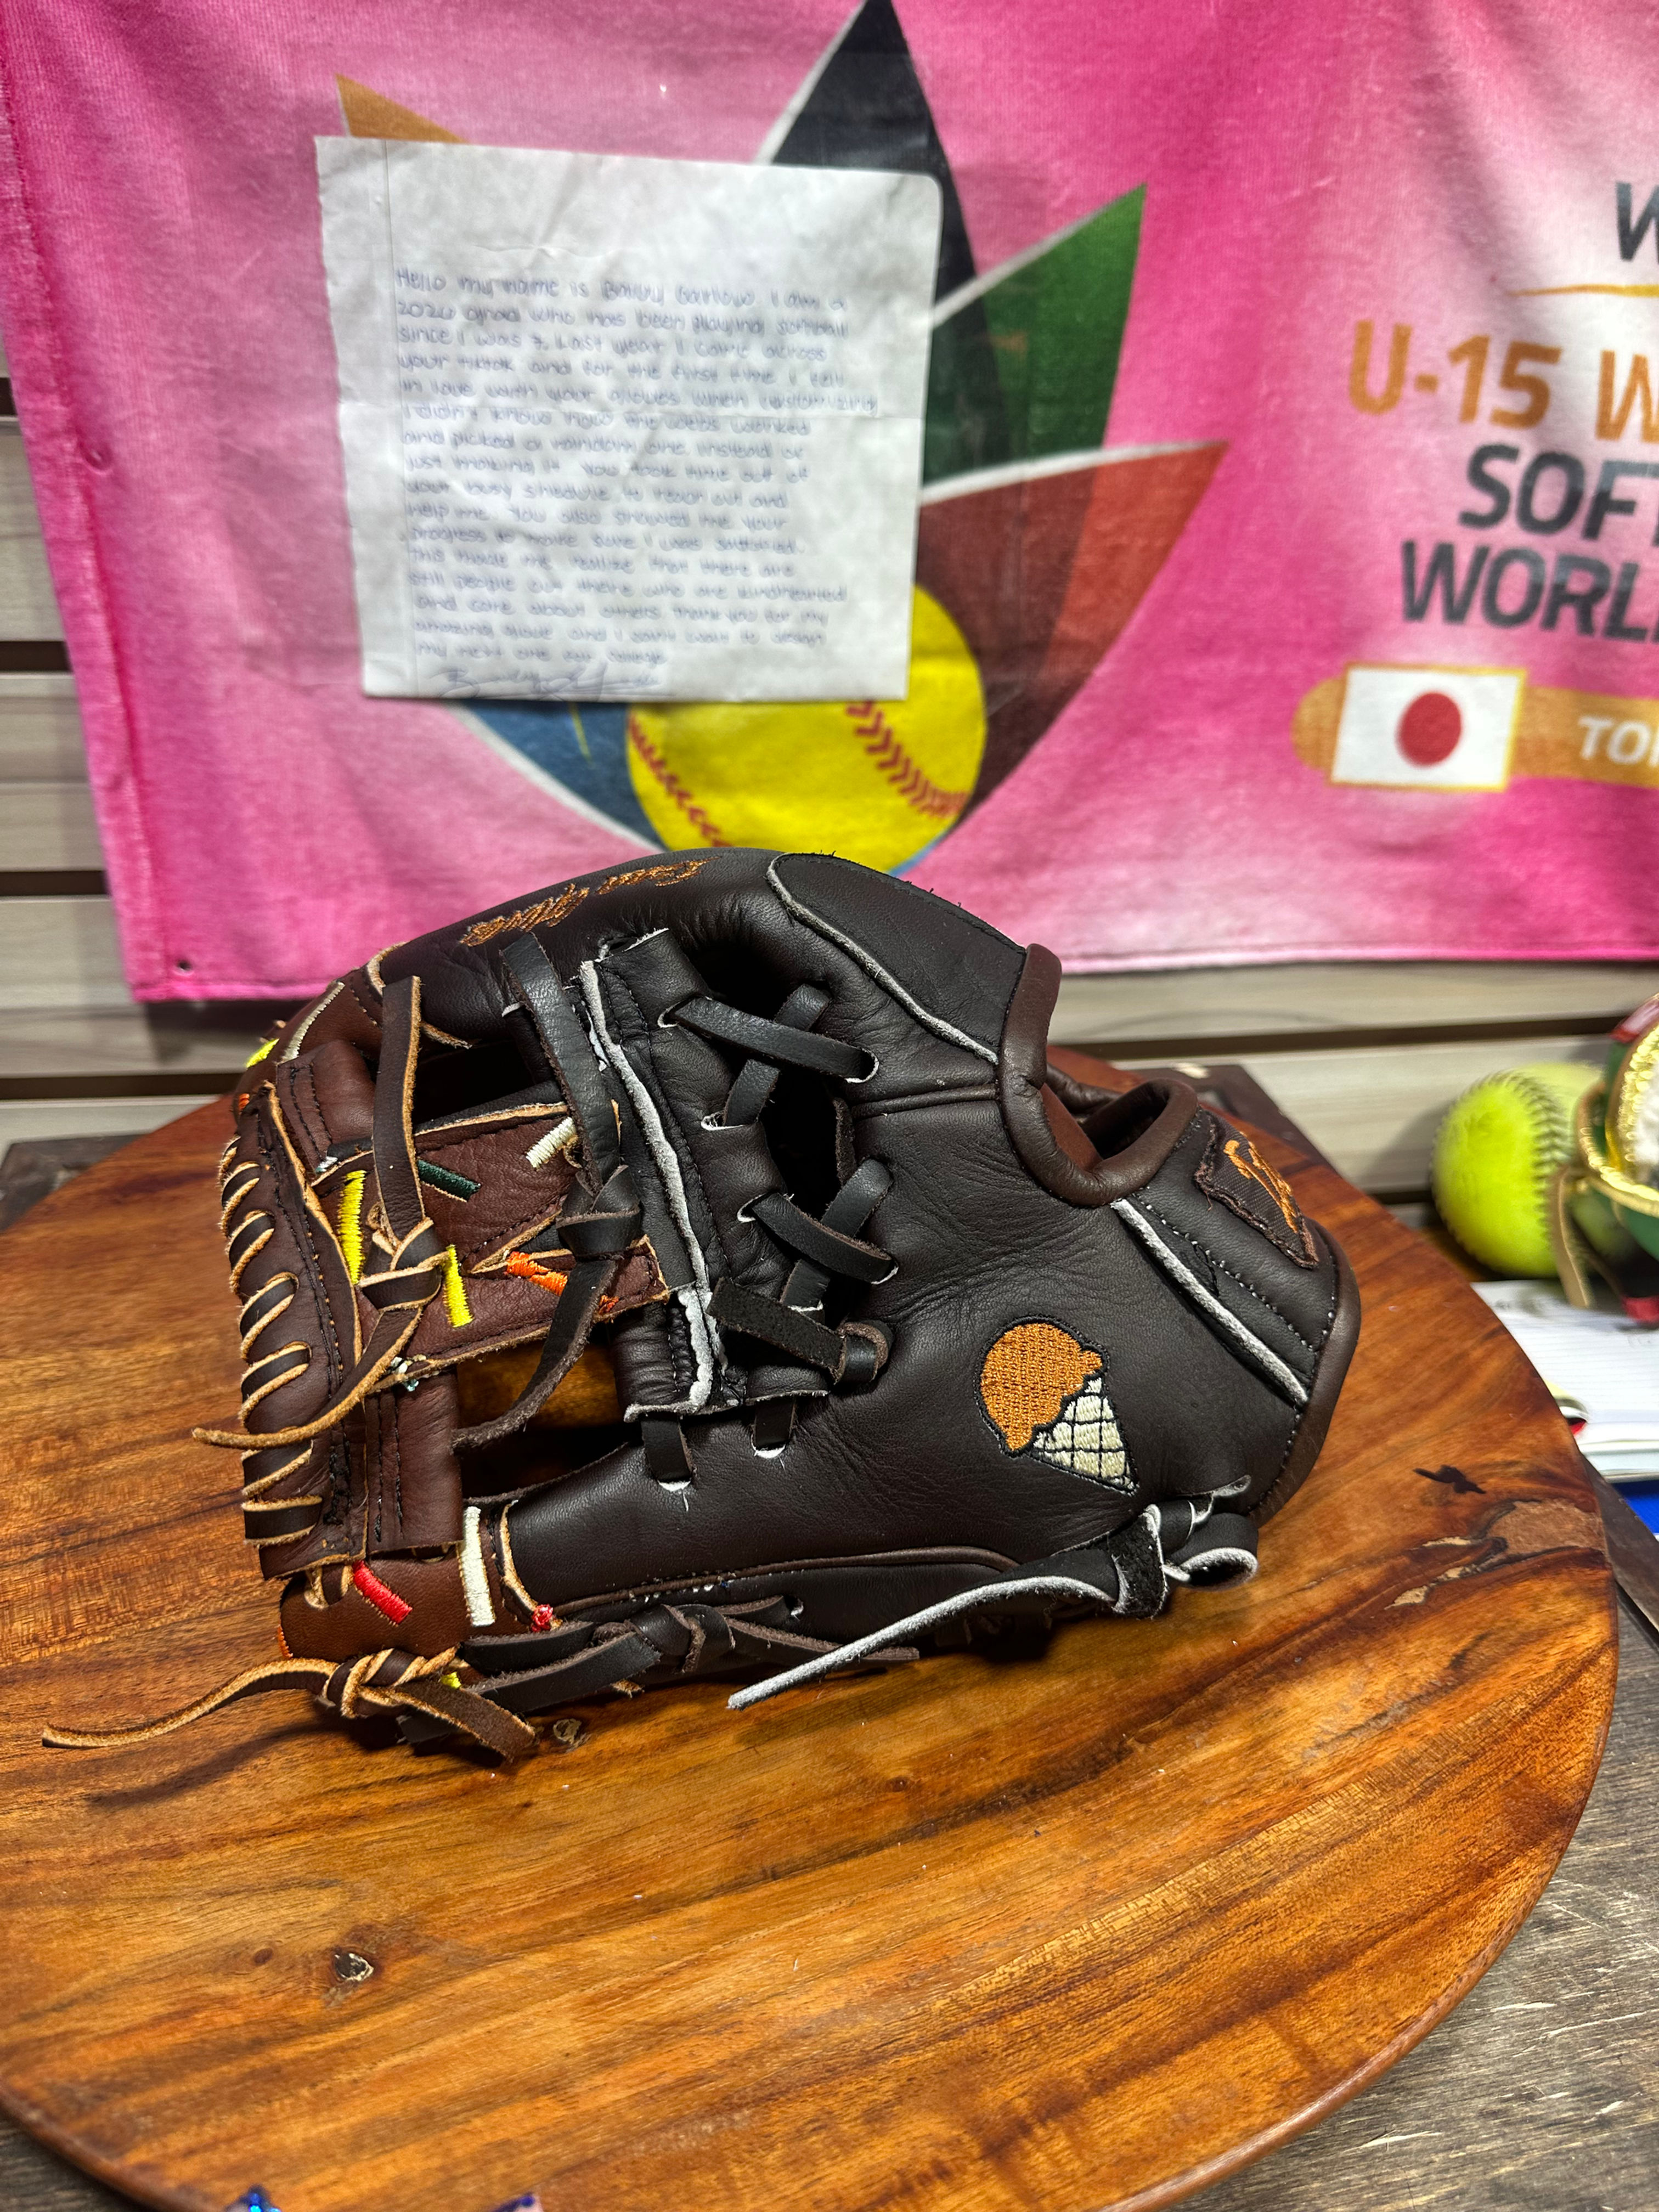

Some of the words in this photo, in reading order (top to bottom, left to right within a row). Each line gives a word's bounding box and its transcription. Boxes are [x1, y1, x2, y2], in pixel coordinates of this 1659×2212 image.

[396, 267, 447, 292] Hello
[458, 276, 494, 298] my
[501, 278, 560, 297] name
[571, 280, 589, 298] is
[785, 291, 820, 309] am
[463, 306, 521, 326] grad
[528, 307, 575, 325] who
[585, 309, 627, 327] has
[635, 309, 685, 331] been
[692, 311, 766, 337] playing
[777, 317, 849, 340] softball
[398, 327, 453, 345] since
[473, 332, 522, 348] was
[611, 338, 665, 358] year
[694, 340, 749, 359] came
[763, 344, 827, 362] across
[397, 354, 450, 371] your
[528, 360, 572, 376] and
[582, 359, 614, 376] for
[627, 364, 662, 380] the
[1347, 320, 1561, 431] U-15
[399, 377, 422, 392] in
[430, 377, 476, 397] love
[484, 381, 538, 398] with
[545, 384, 596, 404] your
[490, 404, 552, 426] know
[399, 430, 445, 445] and
[450, 431, 515, 451] picked
[1458, 443, 1659, 548] SOF
[1401, 541, 1659, 644] WORL
